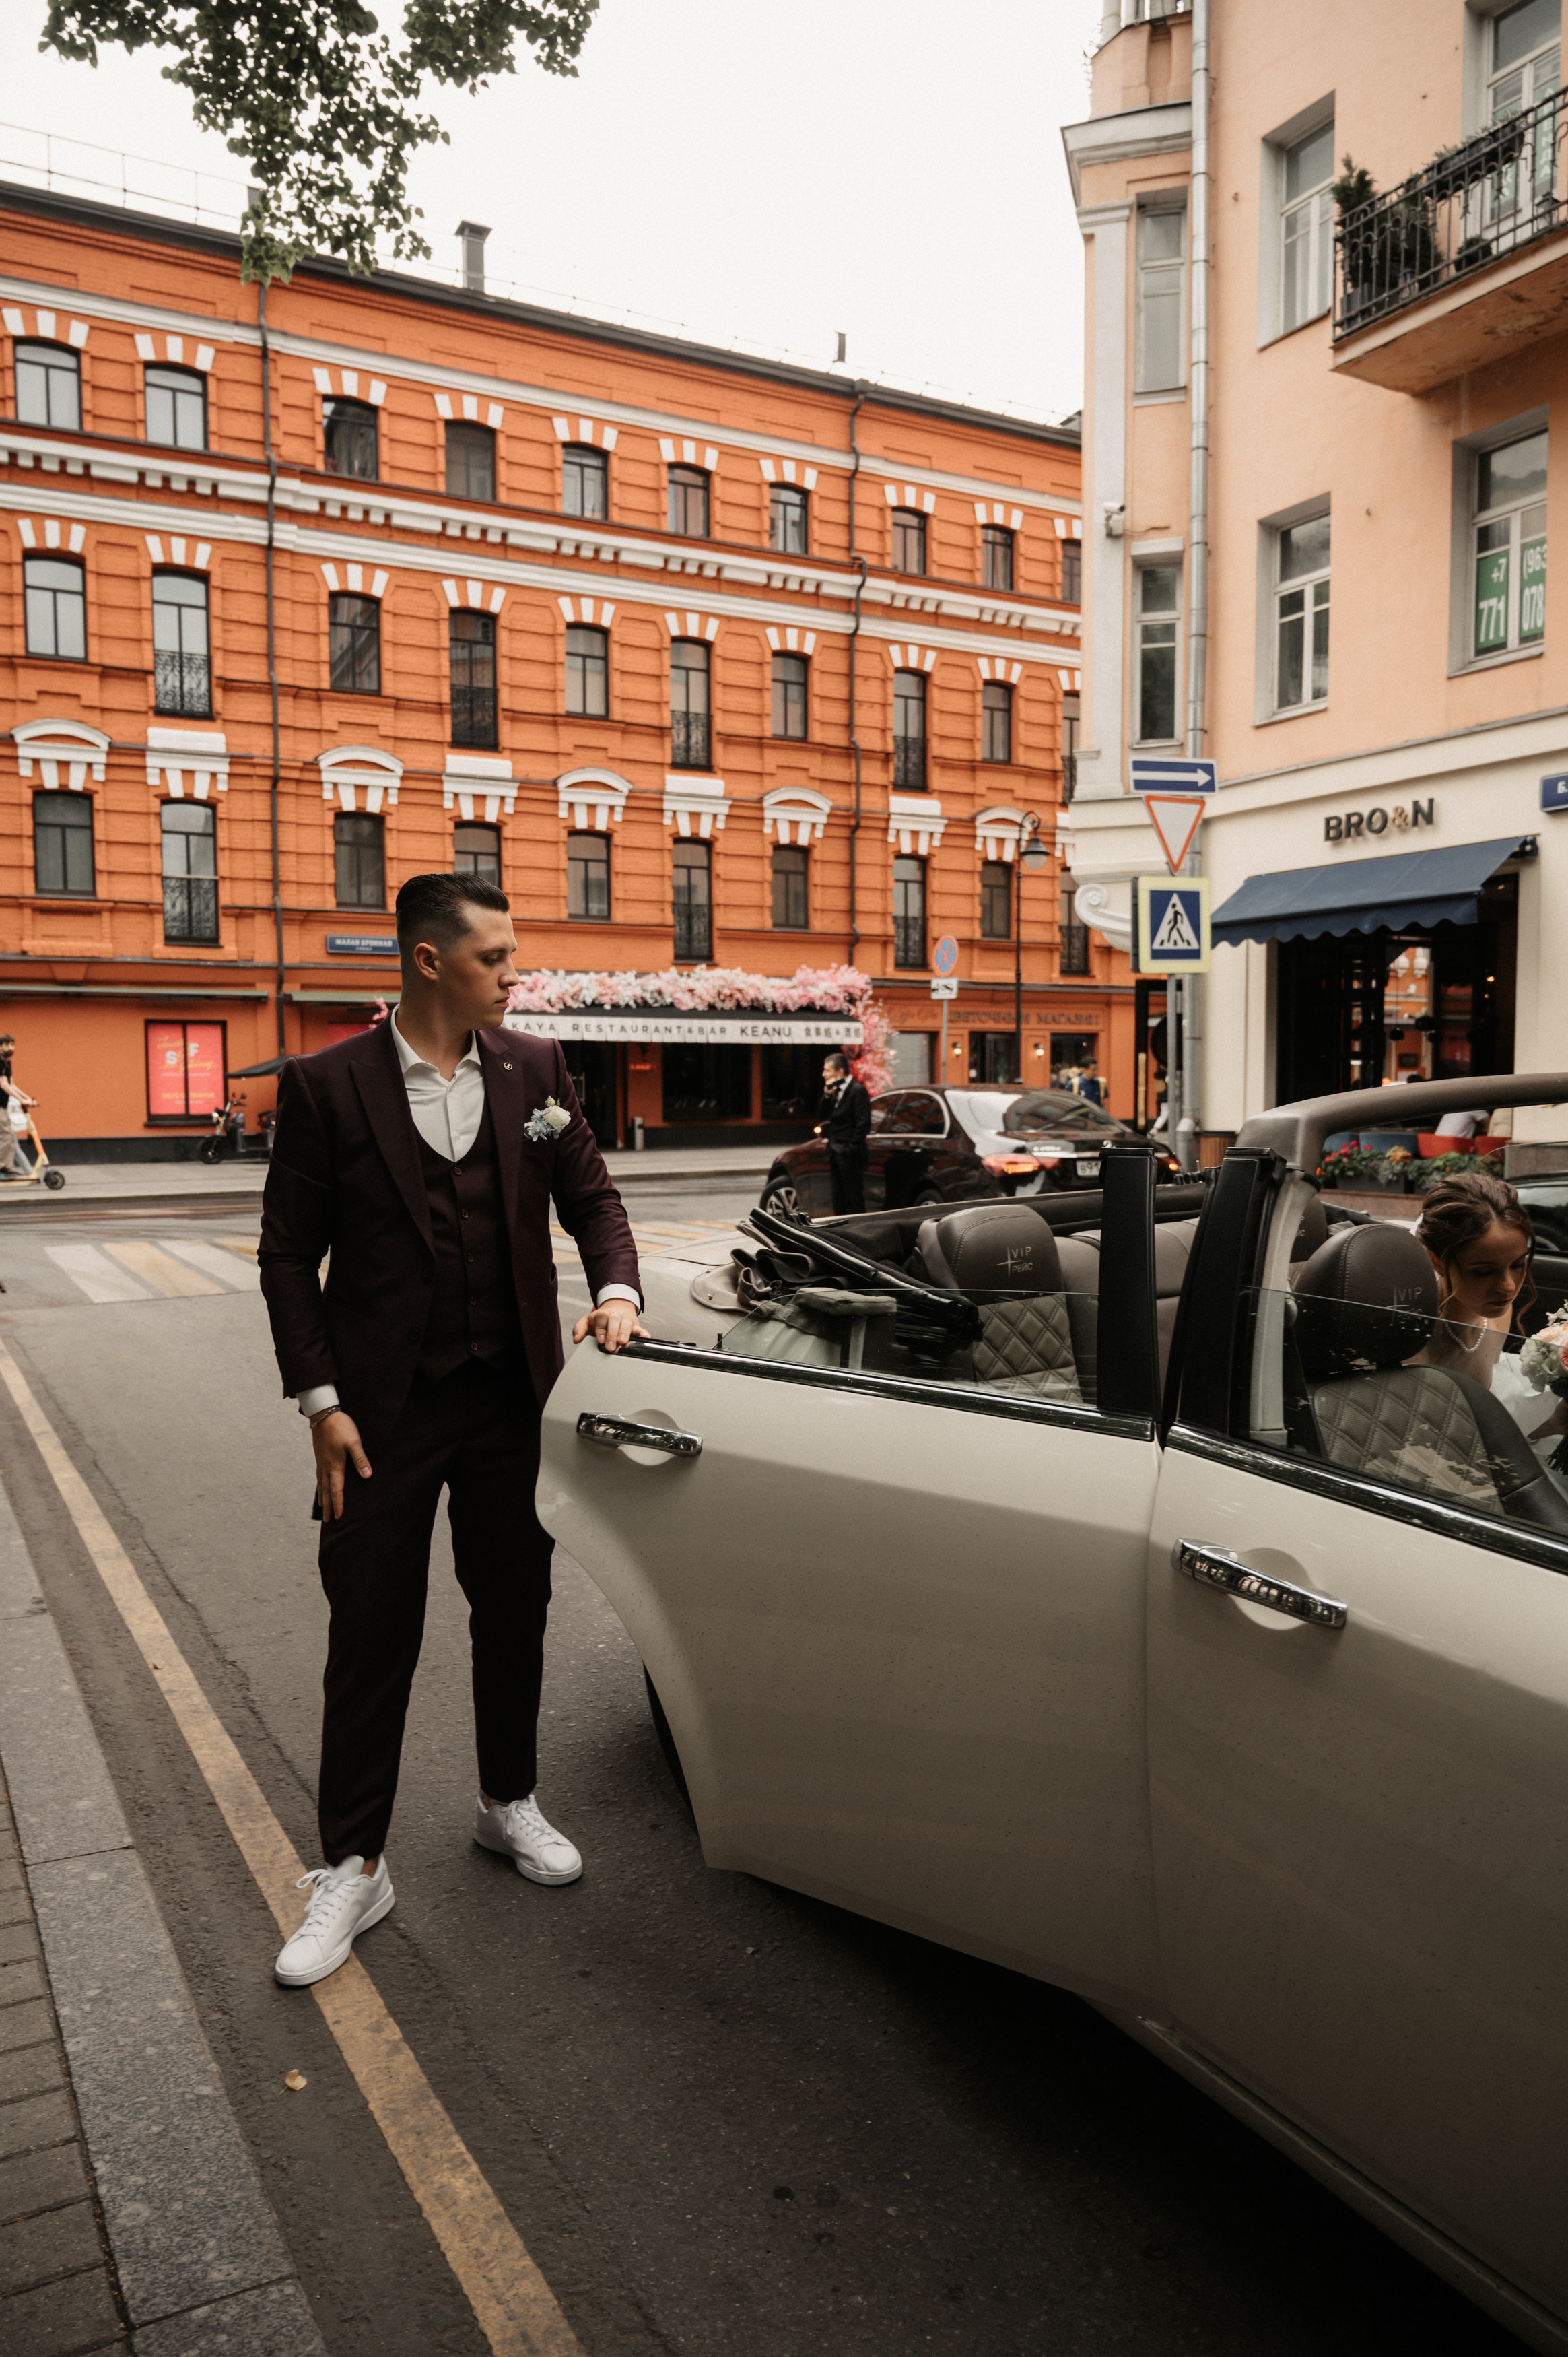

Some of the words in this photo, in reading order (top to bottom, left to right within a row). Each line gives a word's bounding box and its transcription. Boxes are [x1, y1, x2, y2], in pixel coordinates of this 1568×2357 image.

[1491, 557, 1507, 583] +7
[1479, 595, 1505, 642] 771
[1522, 583, 1544, 631] 078
[1324, 798, 1434, 841] BRO&N
[741, 1026, 792, 1037] KEANU
[1011, 1246, 1031, 1258] VIP
[1398, 1287, 1422, 1301] VIP
